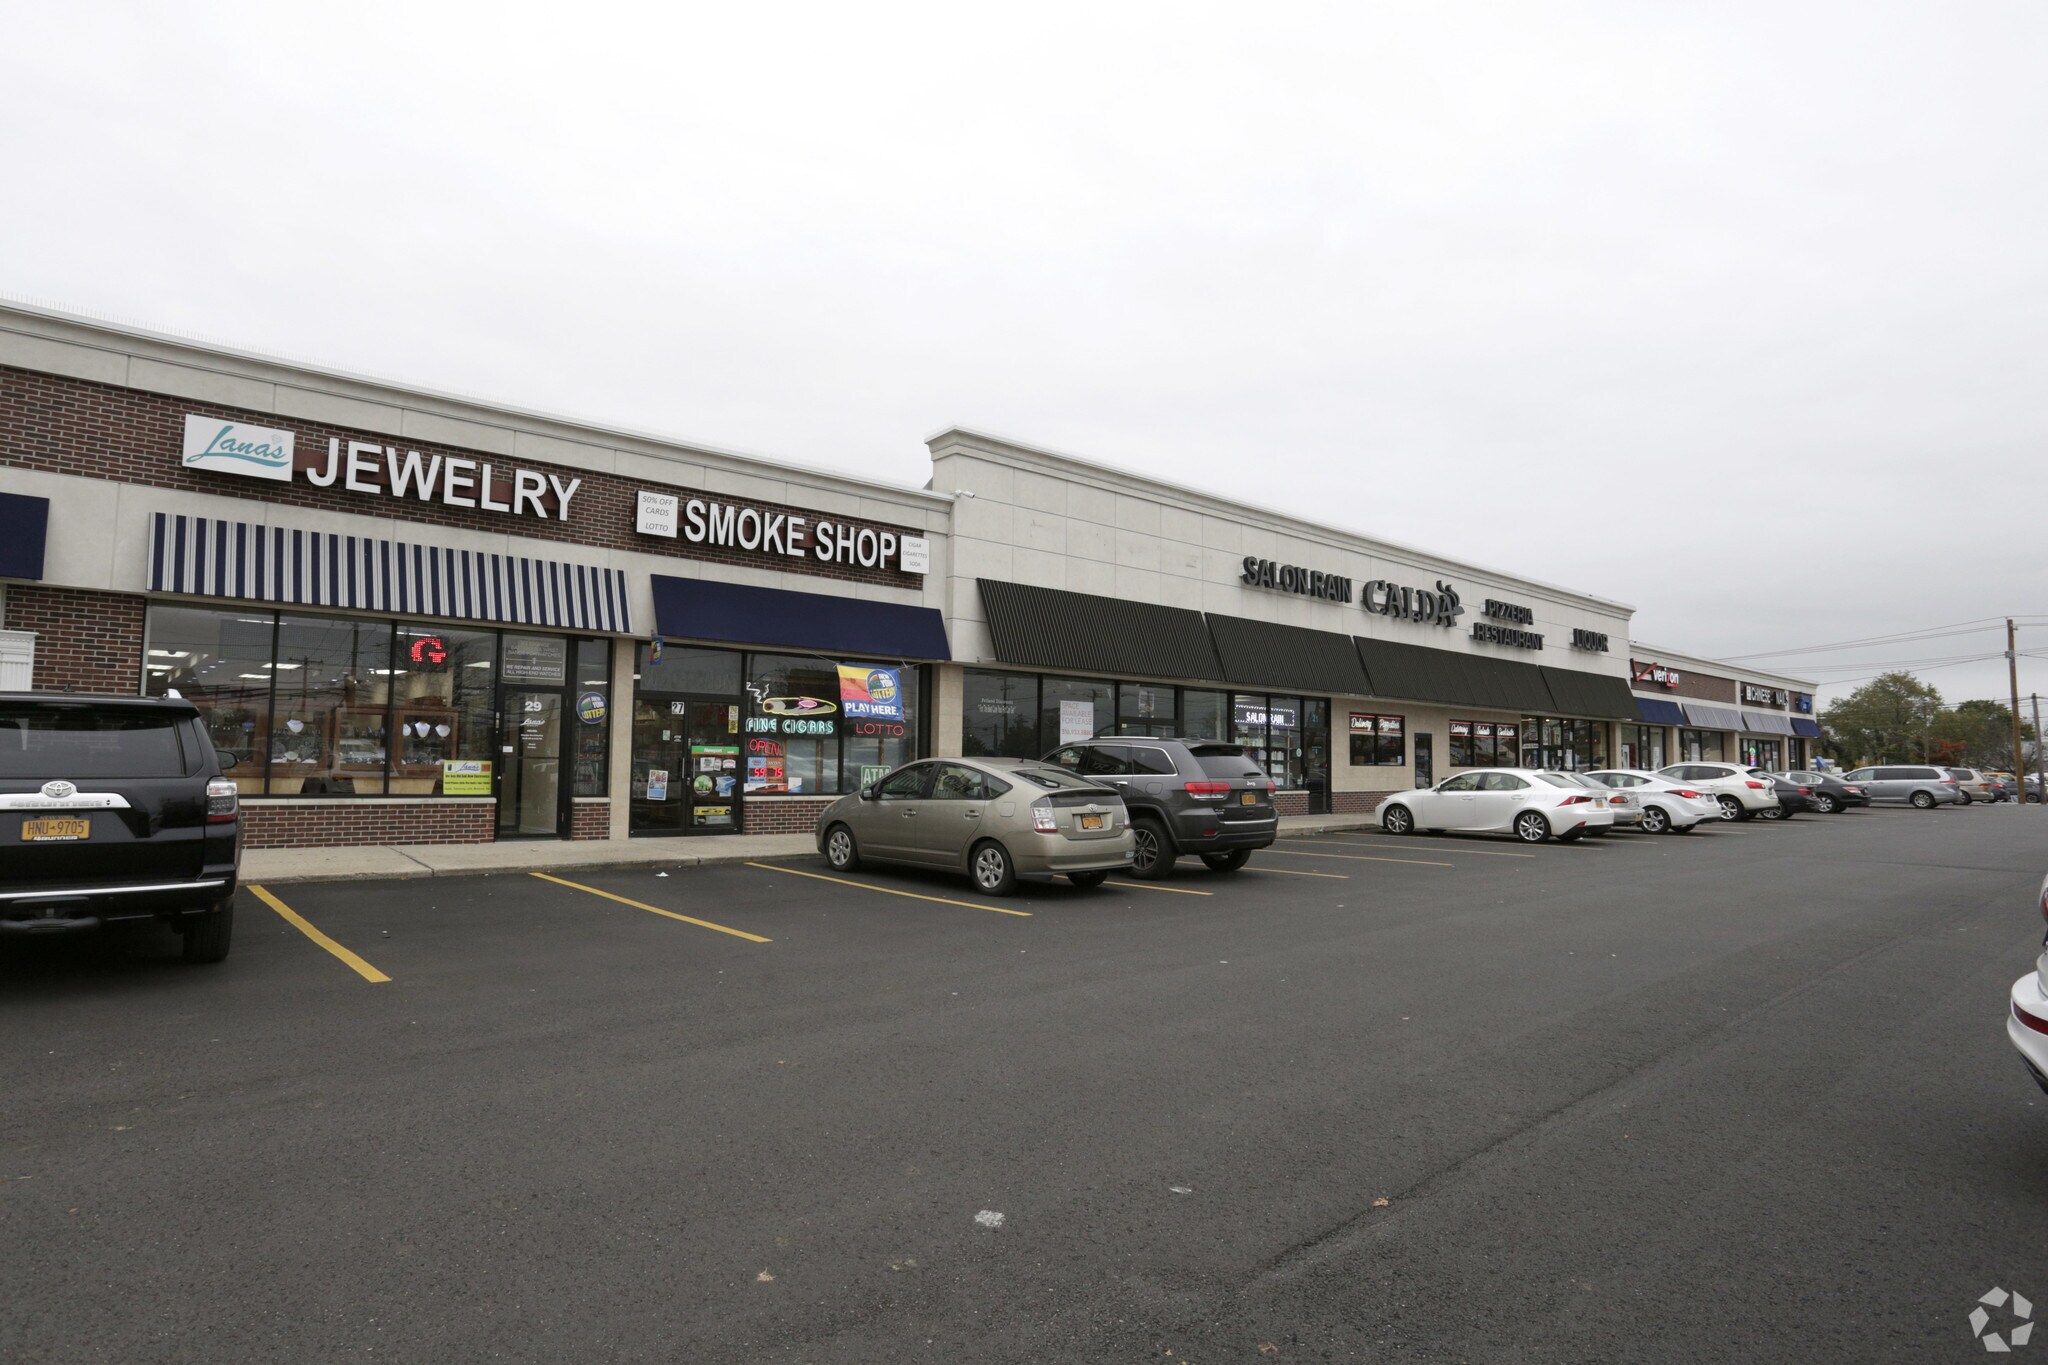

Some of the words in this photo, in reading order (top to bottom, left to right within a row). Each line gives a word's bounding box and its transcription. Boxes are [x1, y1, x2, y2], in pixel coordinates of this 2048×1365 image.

[306, 437, 581, 521] JEWELRY
[642, 495, 658, 504] 50%
[659, 498, 673, 506] OFF
[645, 506, 669, 517] CARDS
[645, 522, 669, 532] LOTTO
[684, 500, 805, 557] SMOKE
[815, 521, 897, 569] SHOP
[902, 550, 928, 559] CIGARETTES
[1242, 556, 1309, 595] SALON
[1310, 570, 1352, 603] RAIN
[1485, 599, 1534, 625] PIZZERIA
[1473, 622, 1545, 650] RESTAURANT
[1573, 628, 1609, 652] LIQUOR
[1653, 667, 1679, 687] verizon
[525, 701, 542, 712] 29
[672, 702, 684, 714] 27
[845, 702, 870, 714] PLAY
[871, 704, 899, 716] HERE.
[745, 717, 777, 733] FINE
[782, 719, 834, 735] CIGARS
[1062, 717, 1074, 725] FOR
[1074, 718, 1092, 726] LEASE
[1351, 717, 1372, 731] Delivery
[855, 723, 904, 736] LOTTO
[749, 738, 781, 756] OPEN
[863, 768, 890, 784] ATM
